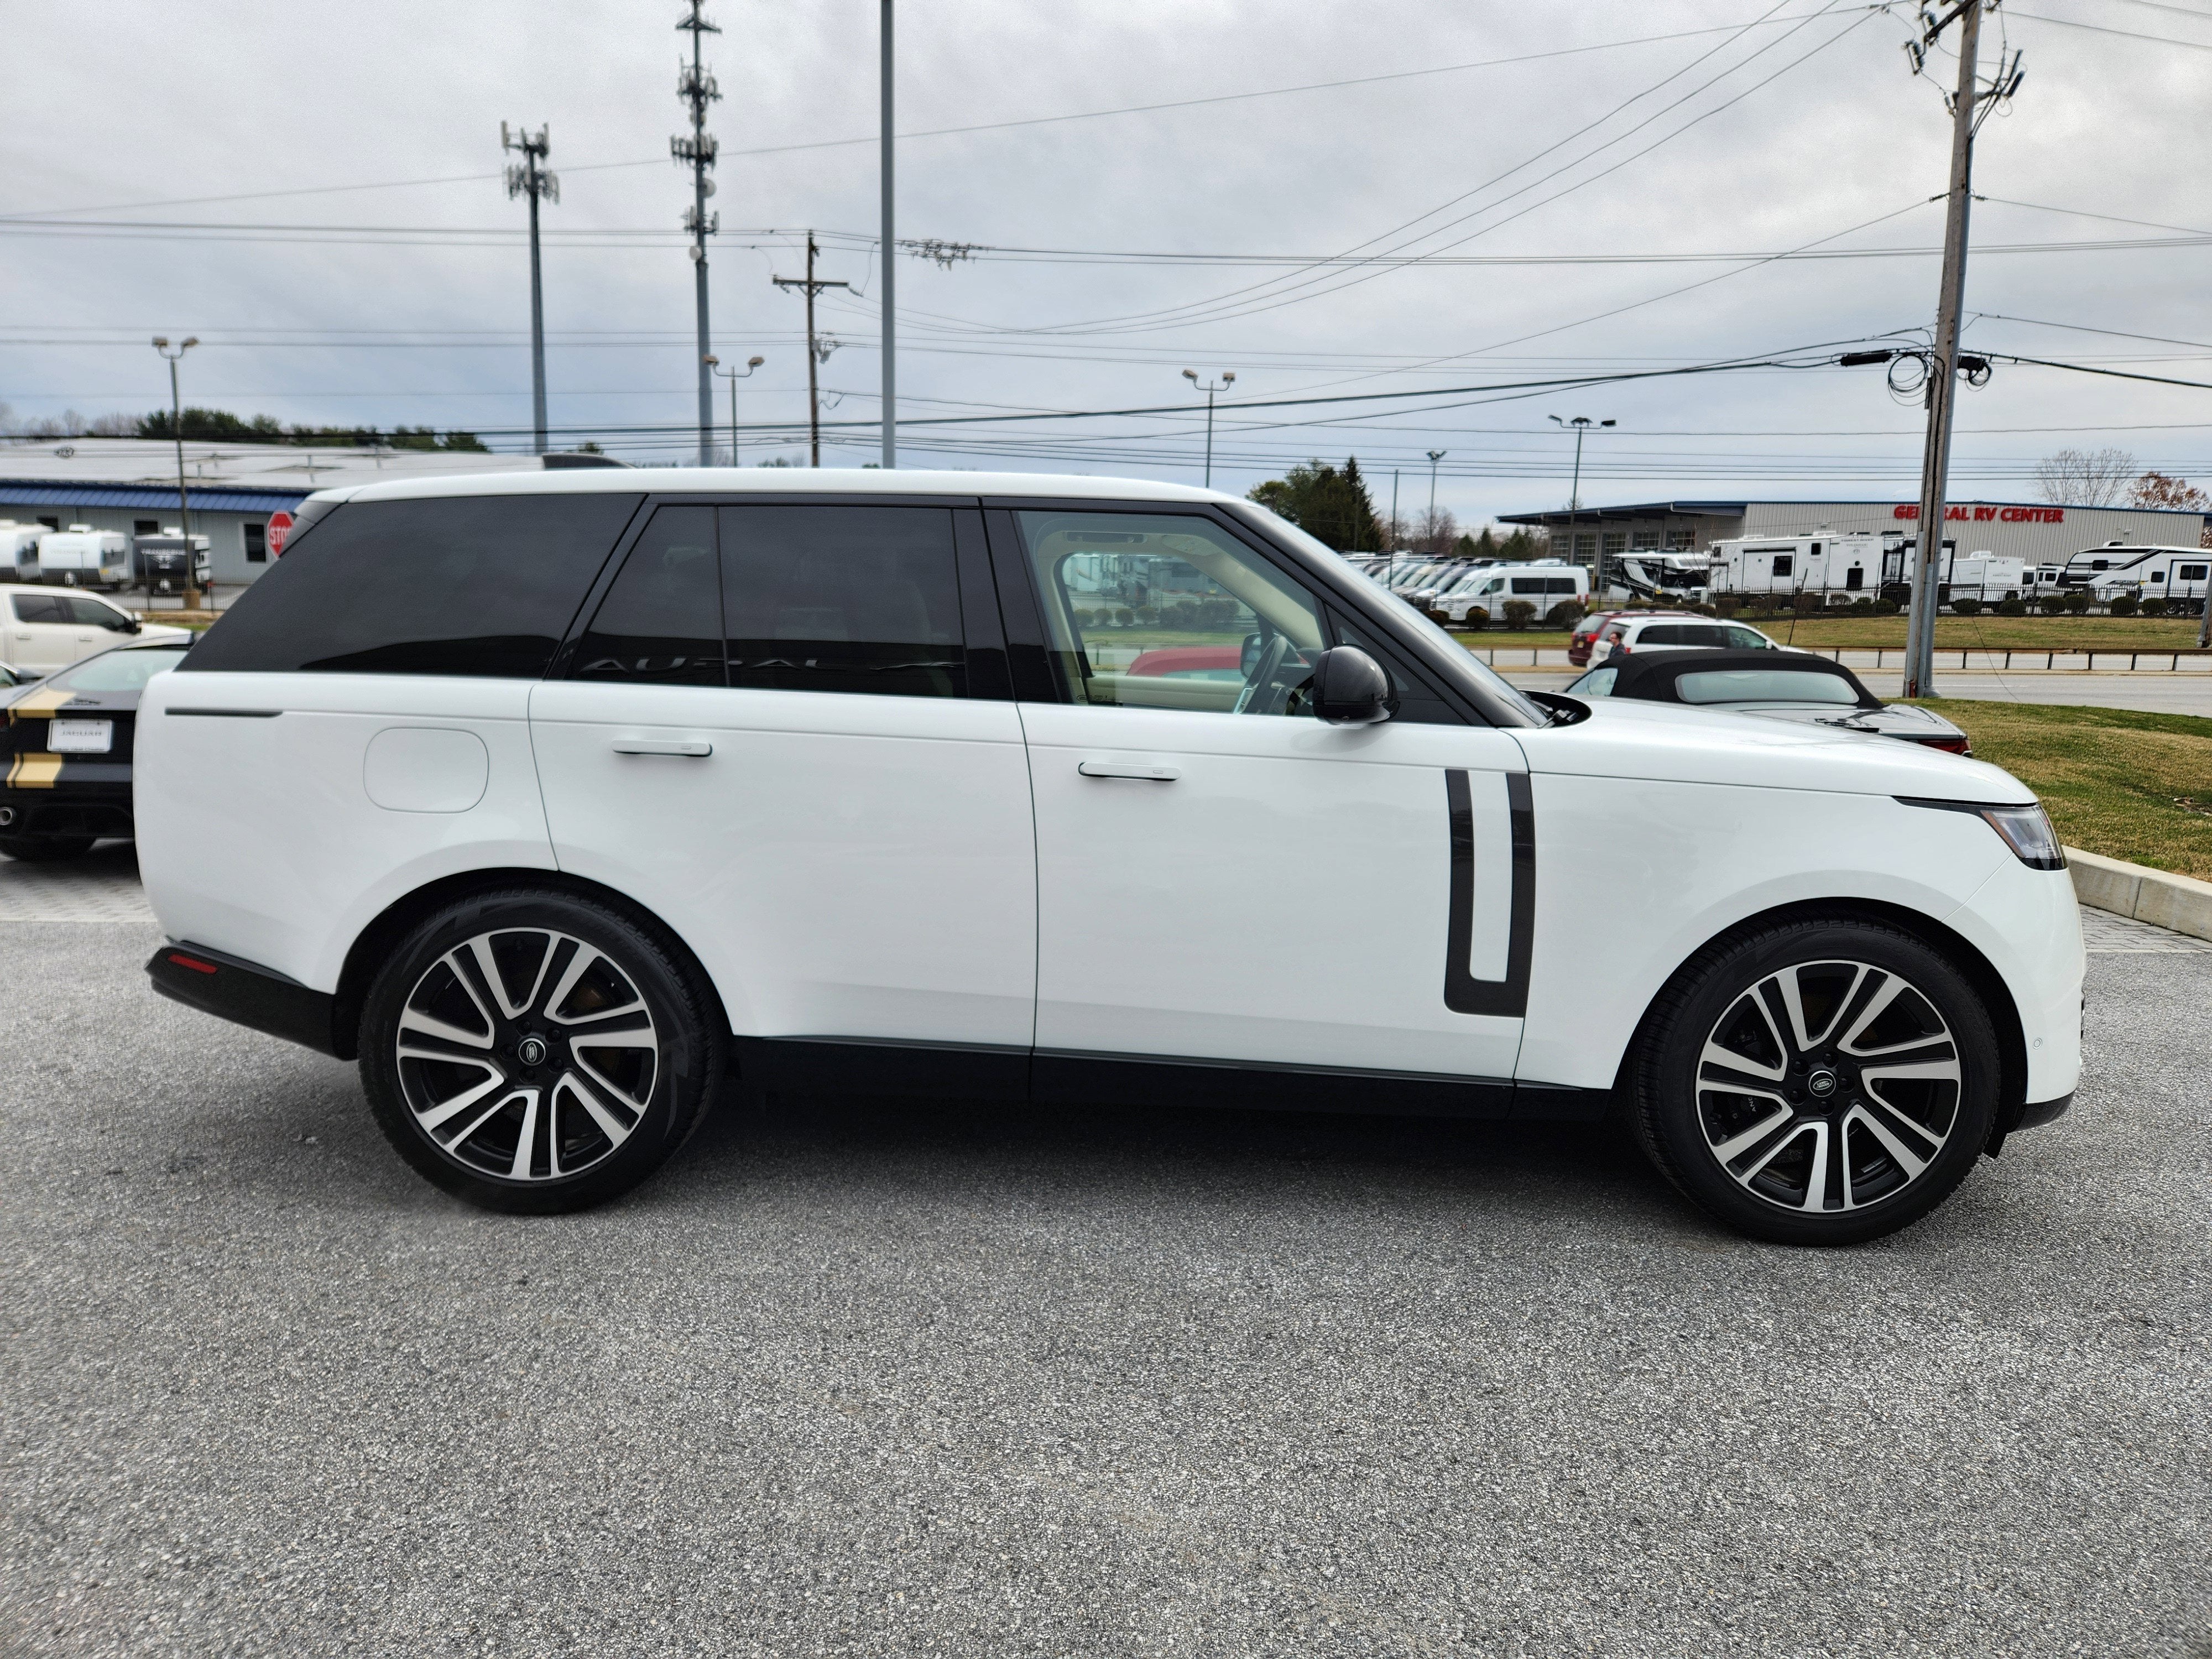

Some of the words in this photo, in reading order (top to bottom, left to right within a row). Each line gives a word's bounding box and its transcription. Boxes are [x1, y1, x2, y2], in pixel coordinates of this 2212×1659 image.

[1894, 505, 1970, 521] GEAL
[1975, 507, 1997, 521] RV
[2001, 508, 2064, 523] CENTER
[269, 526, 290, 545] STO
